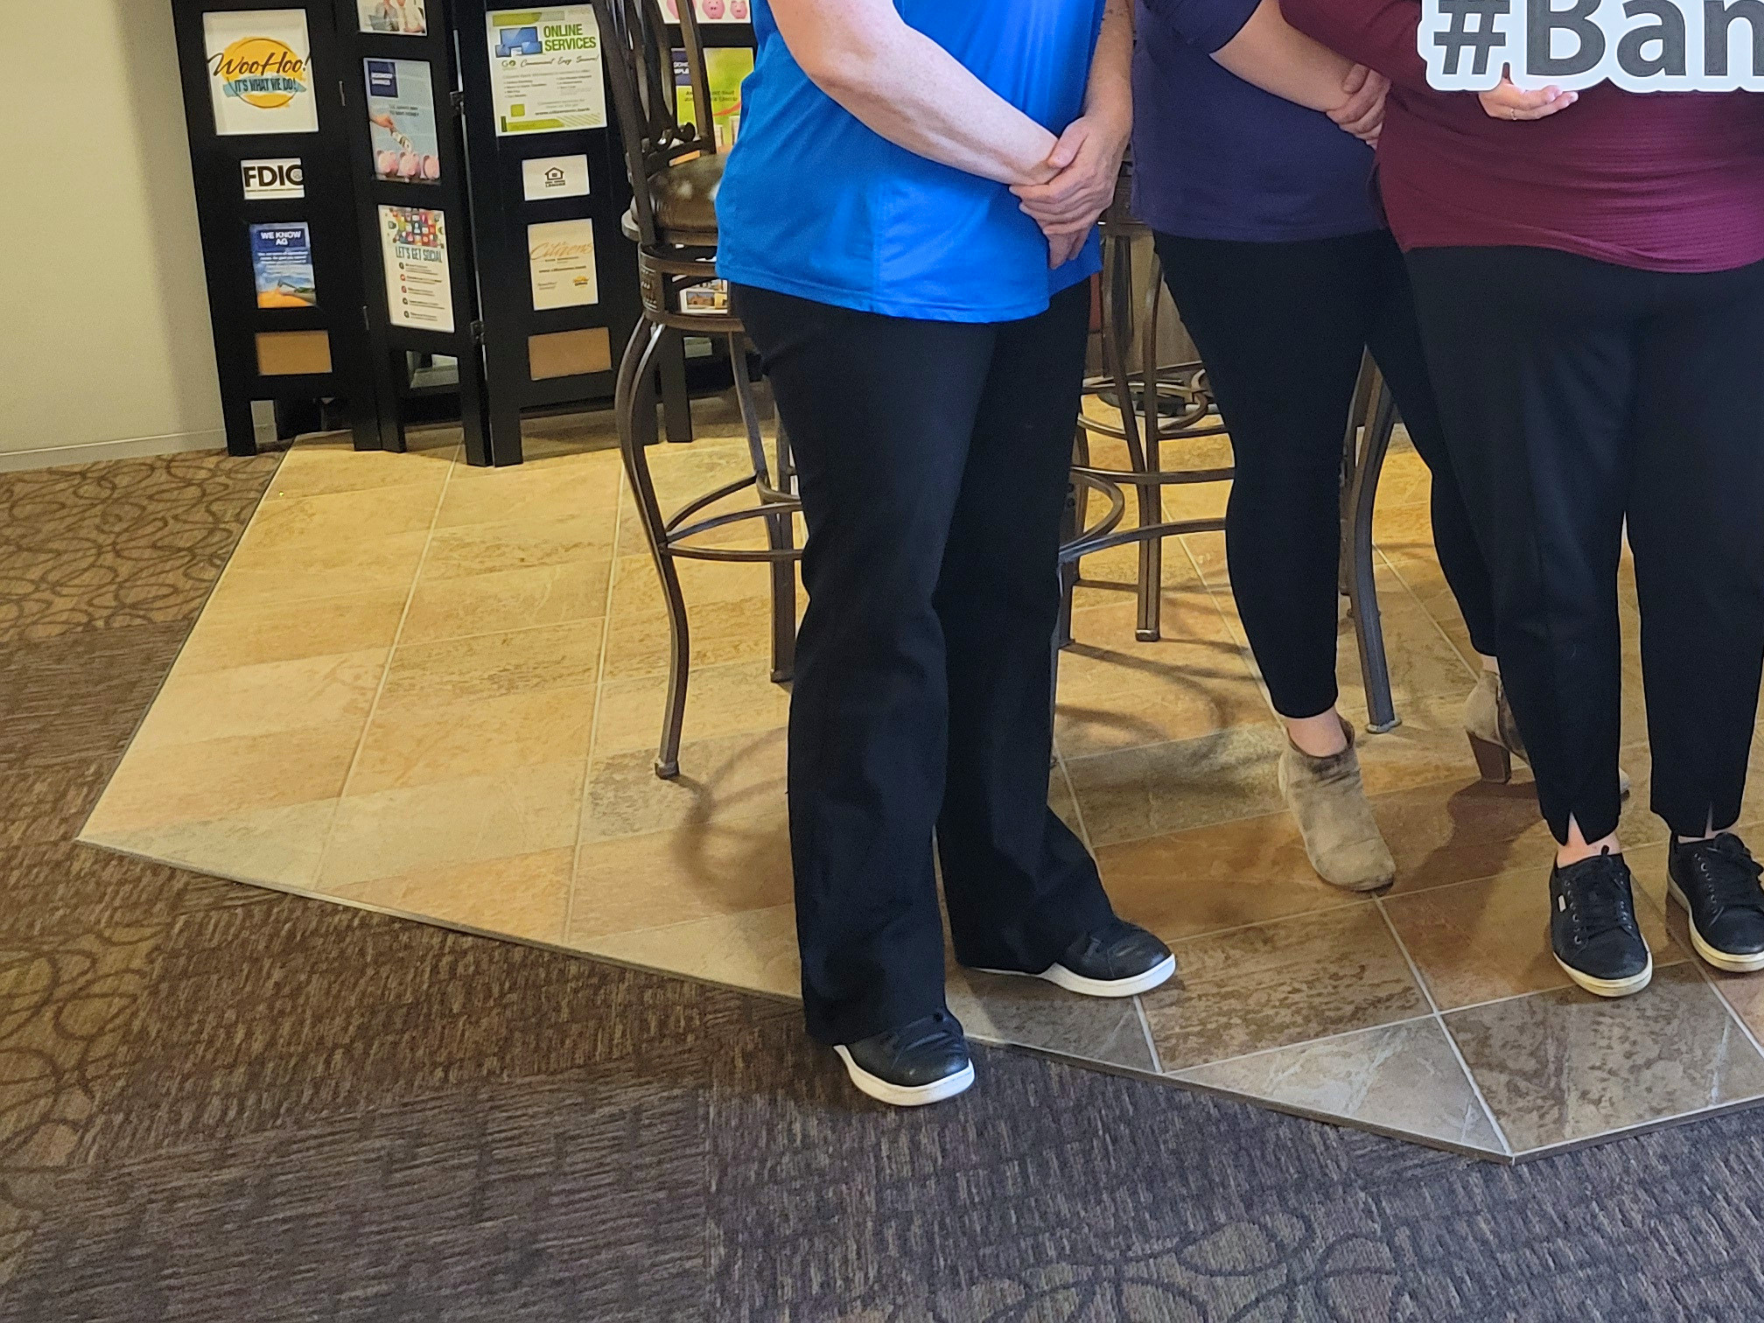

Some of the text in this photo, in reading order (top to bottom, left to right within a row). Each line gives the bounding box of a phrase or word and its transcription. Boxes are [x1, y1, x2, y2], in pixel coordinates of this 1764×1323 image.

[543, 24, 583, 38] ONLINE
[544, 37, 597, 52] SERVICES
[207, 51, 311, 76] WooHoo!
[249, 79, 270, 92] WHAT
[271, 78, 281, 91] WE
[283, 77, 297, 91] DO!
[243, 164, 304, 188] FDIC
[260, 230, 302, 239] WE KNOW
[276, 238, 289, 246] AG
